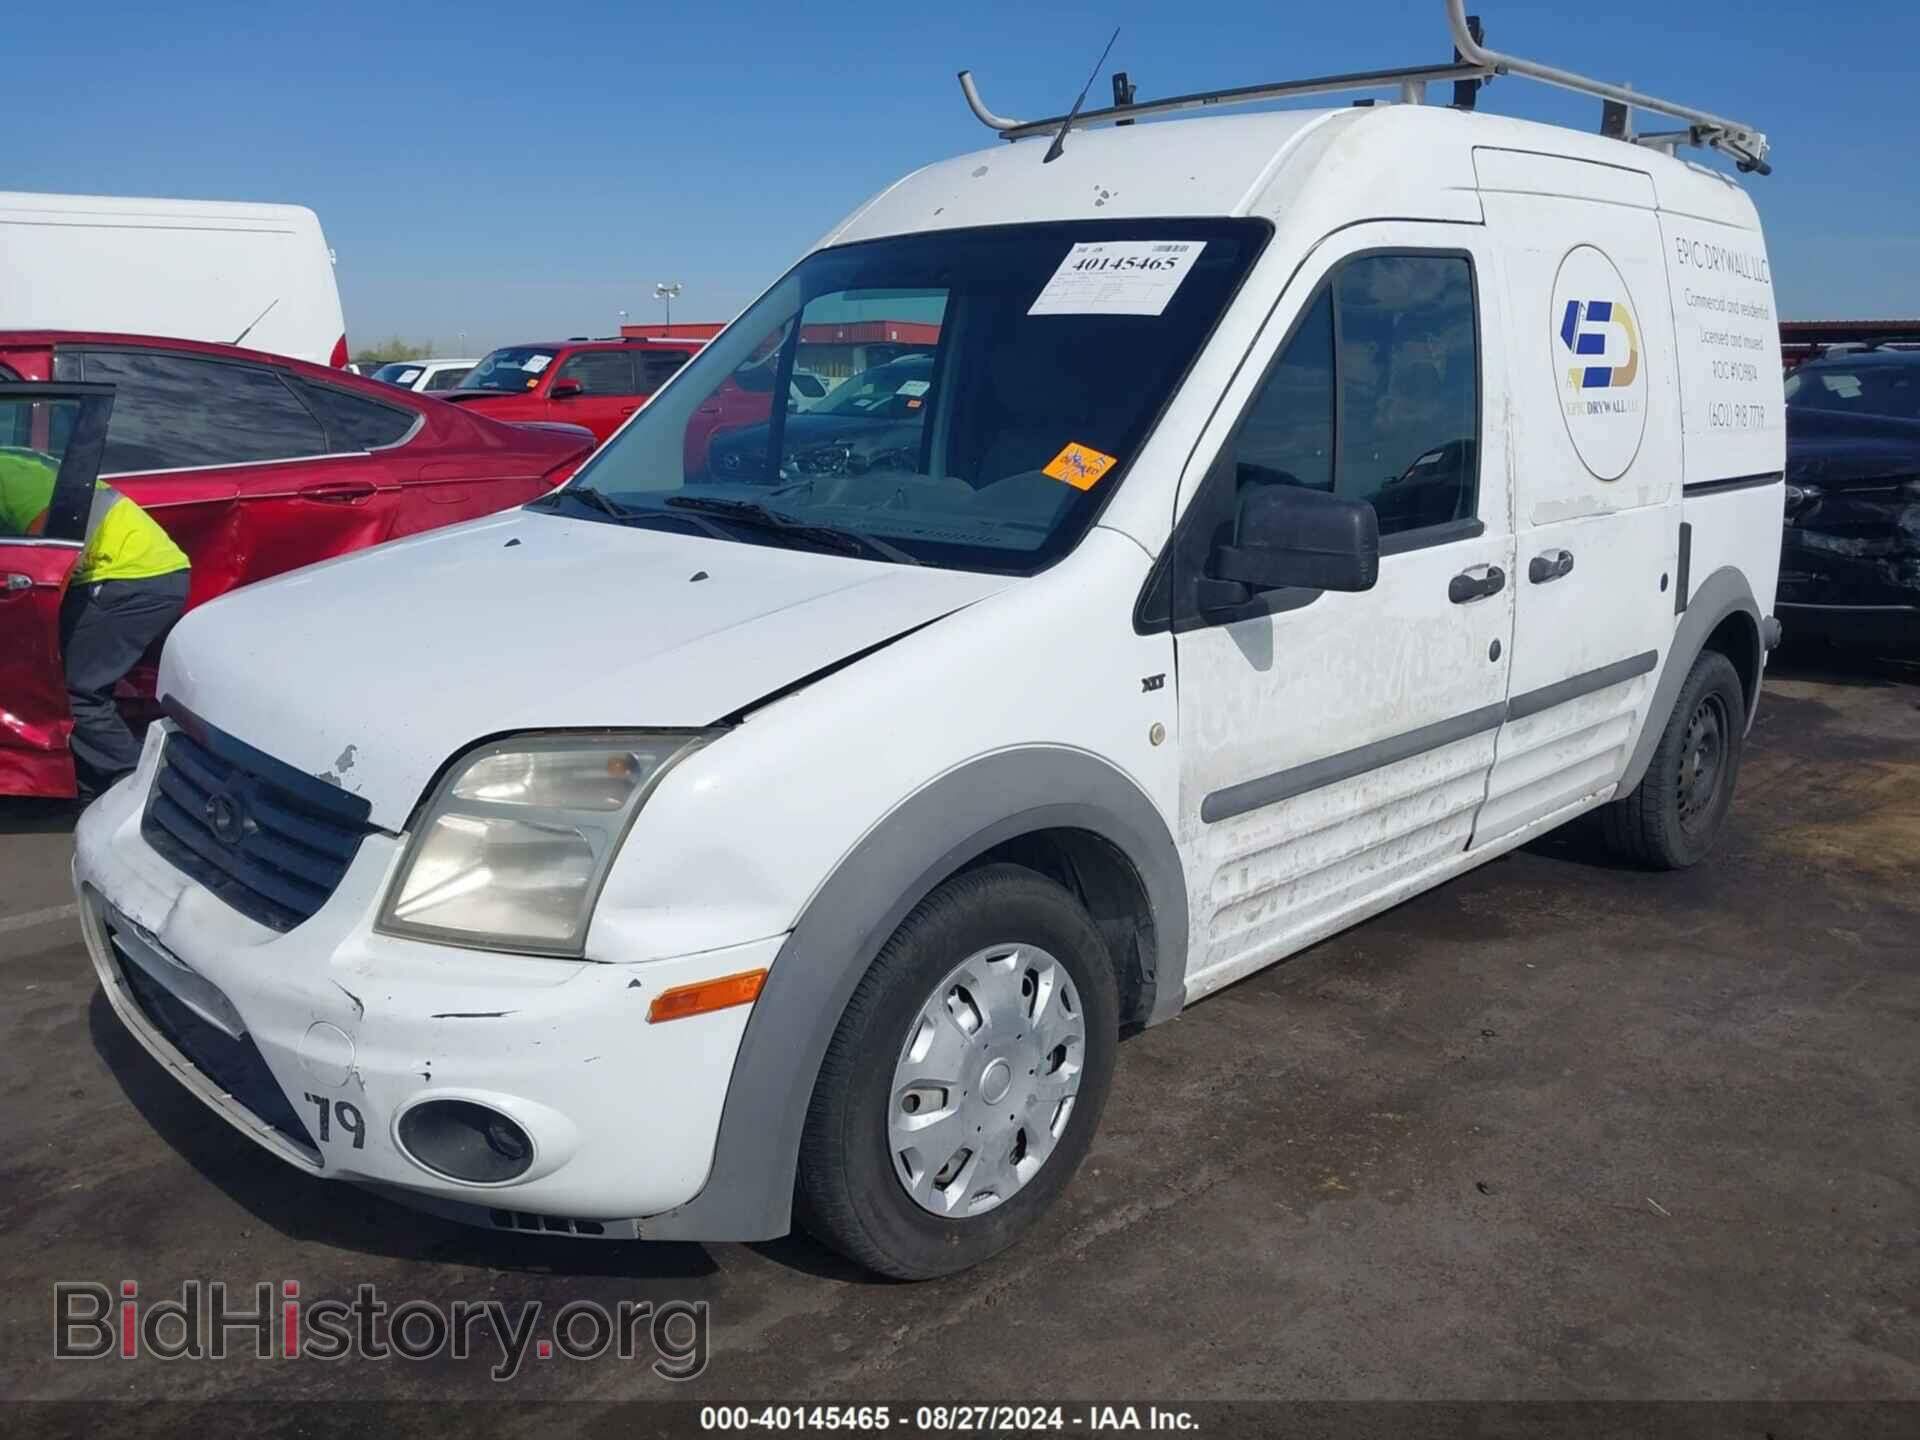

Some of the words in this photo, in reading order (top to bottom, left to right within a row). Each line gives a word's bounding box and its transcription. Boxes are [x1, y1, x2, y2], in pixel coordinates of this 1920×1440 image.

[1072, 256, 1178, 272] 40145465
[1675, 236, 1703, 268] EPIC
[1704, 243, 1751, 280] DRYWALL
[1751, 255, 1769, 284] LLC
[1586, 400, 1625, 415] DRYWALL
[304, 1091, 365, 1150] 79
